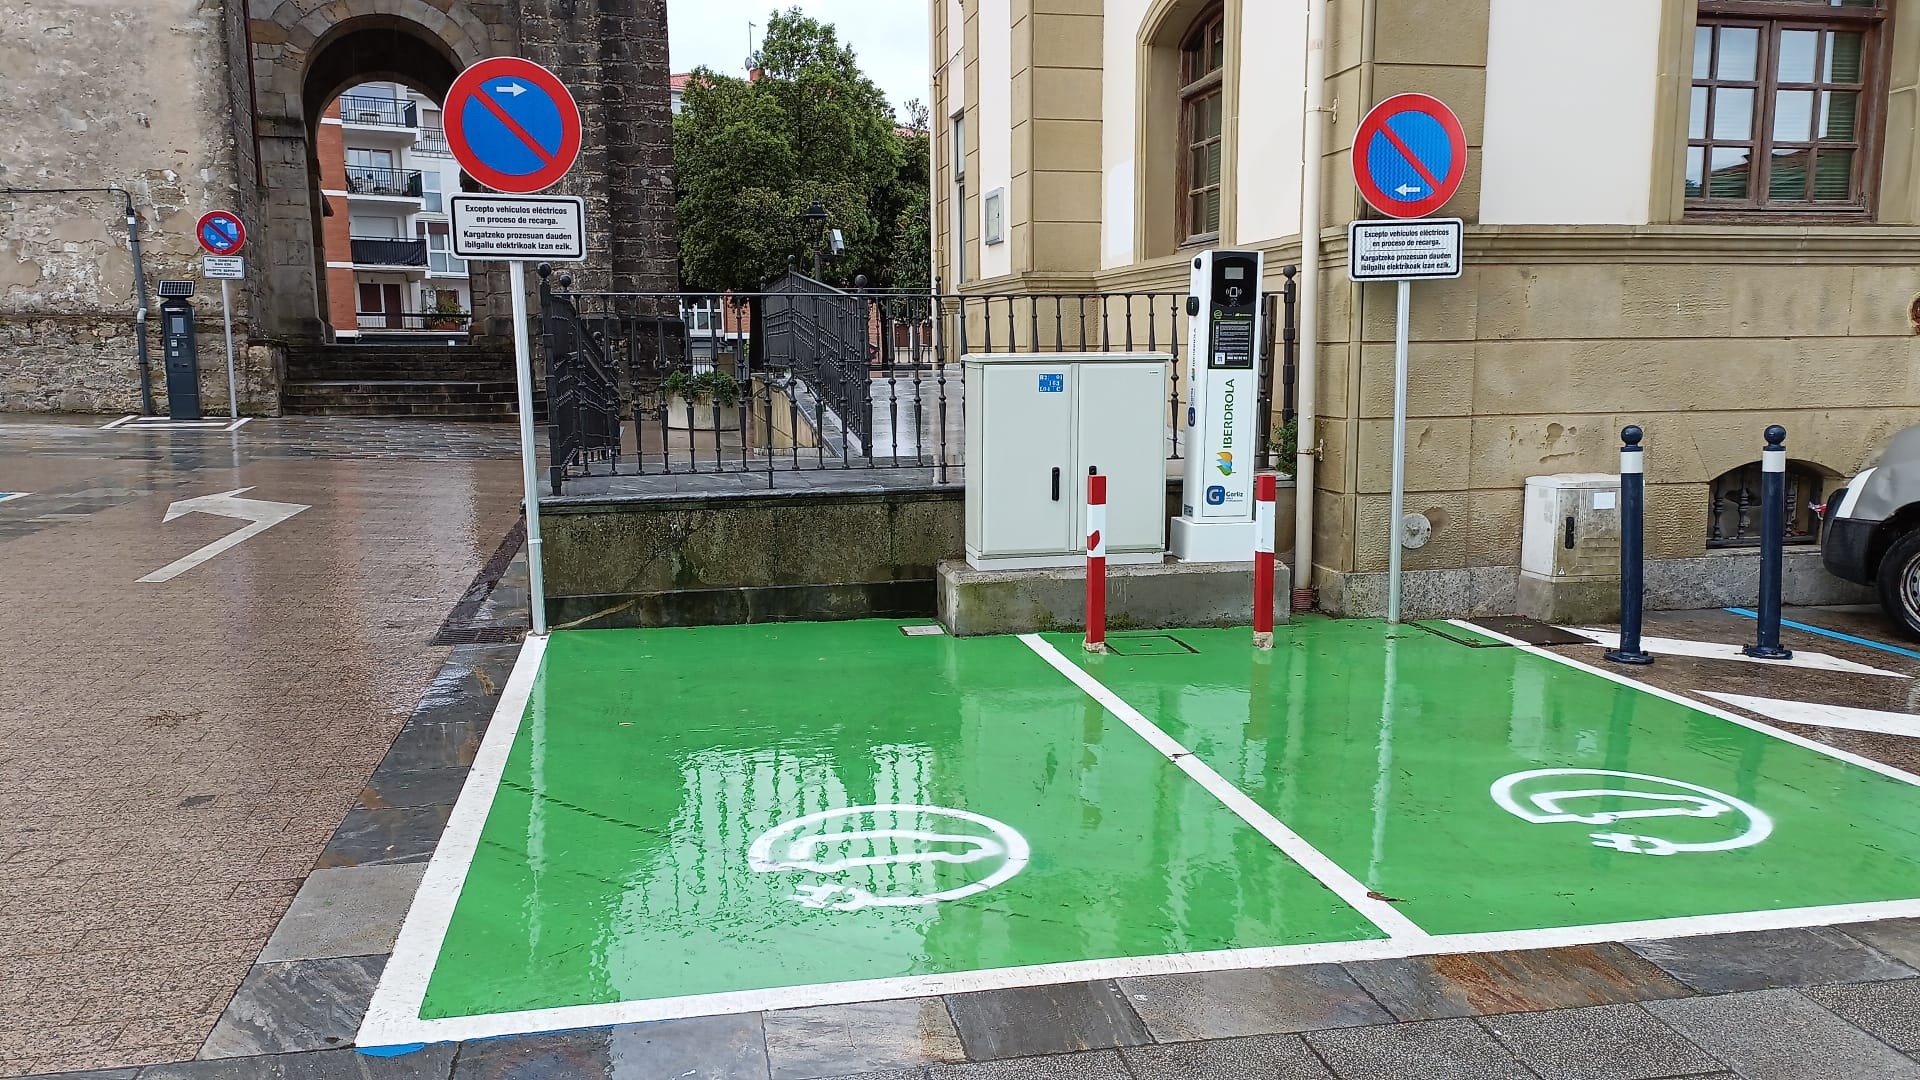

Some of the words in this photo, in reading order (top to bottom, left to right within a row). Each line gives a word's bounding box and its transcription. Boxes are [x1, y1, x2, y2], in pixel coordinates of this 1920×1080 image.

[465, 204, 494, 213] Excepto
[532, 205, 568, 214] eléctricos
[518, 216, 527, 224] de
[528, 218, 558, 226] recarga.
[464, 230, 505, 239] Kargatzeko
[506, 232, 544, 240] prozesuan
[546, 232, 572, 240] dauden
[1364, 230, 1388, 238] Excepto
[496, 241, 536, 250] elektrikoak
[538, 242, 554, 250] izan
[554, 242, 572, 250] ezik.
[1382, 240, 1406, 248] proceso
[1361, 254, 1395, 262] Kargatzeko
[1386, 262, 1420, 270] elektrikoak
[1222, 378, 1235, 448] IBERDROLA
